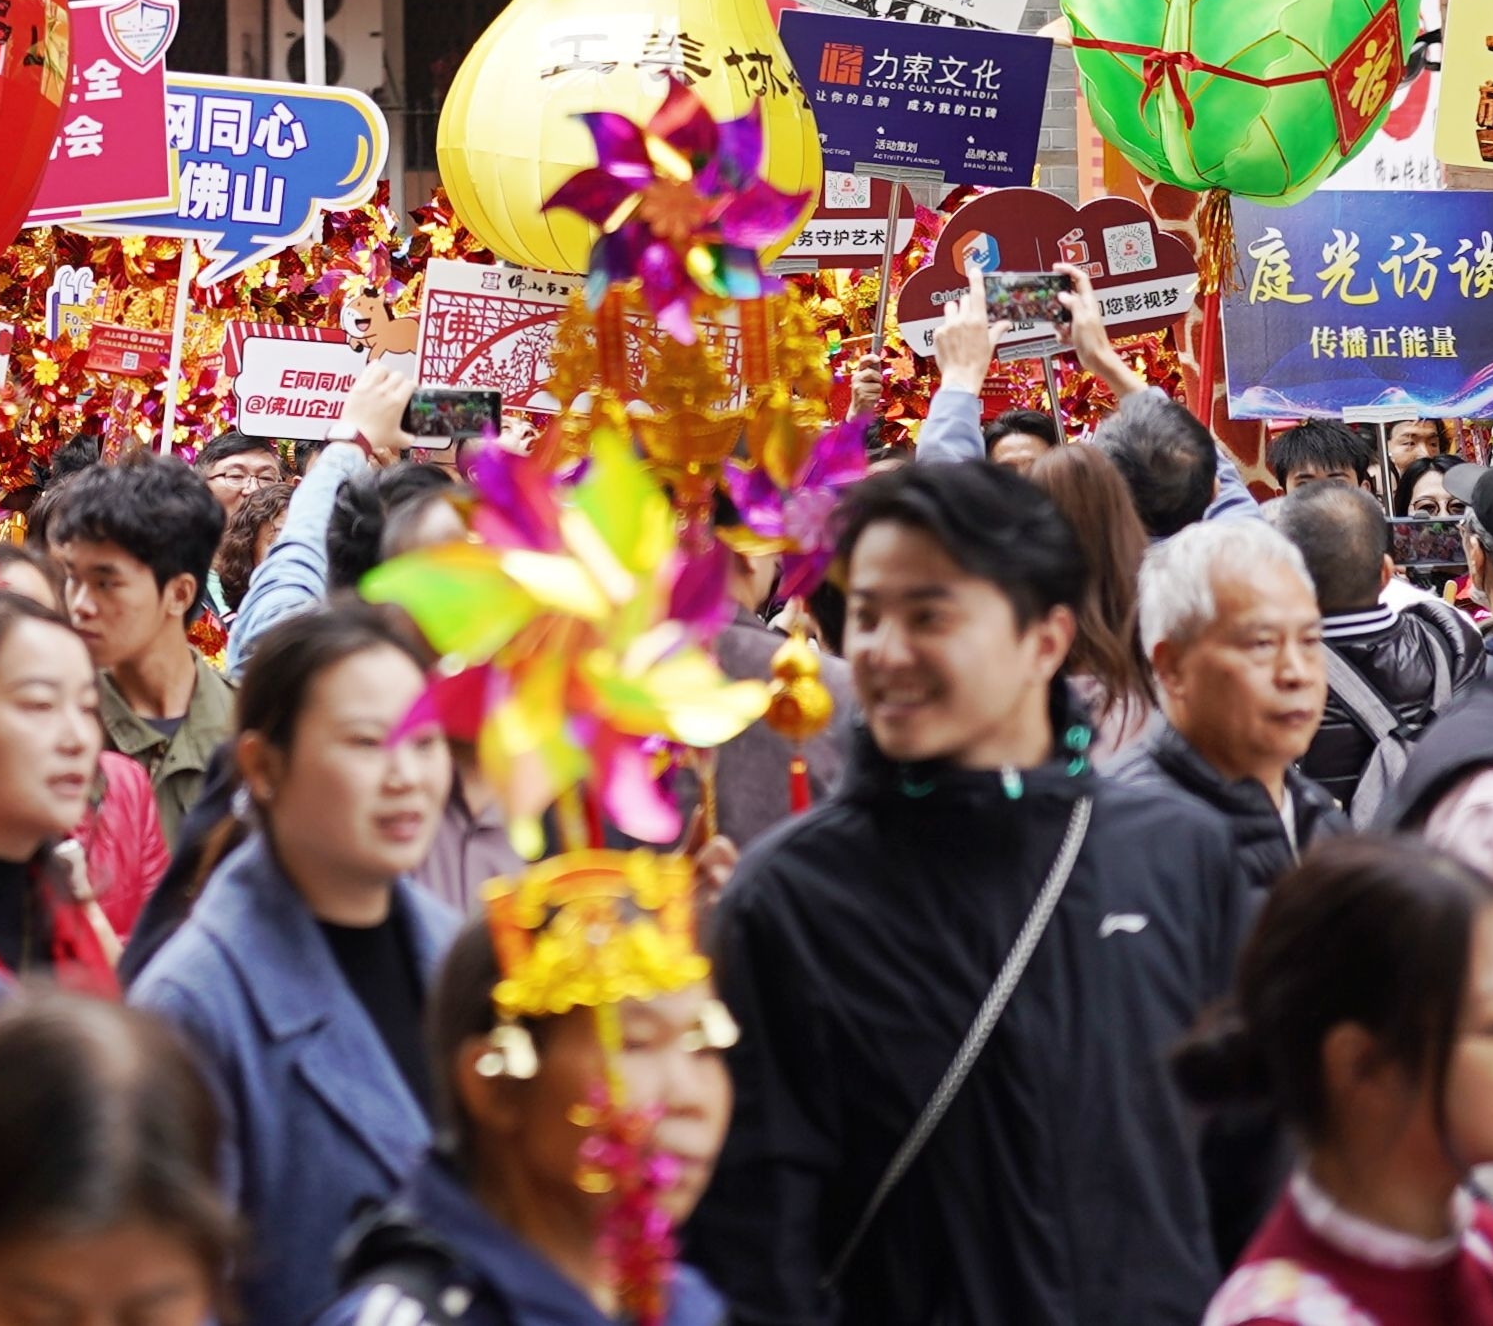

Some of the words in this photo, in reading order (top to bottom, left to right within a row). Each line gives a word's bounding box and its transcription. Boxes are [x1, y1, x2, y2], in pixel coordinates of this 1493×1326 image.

[69, 58, 122, 103] 全
[867, 49, 1002, 90] 力索文化
[816, 89, 891, 108] 让你的品牌
[907, 99, 998, 119] 成为我的口碑
[909, 85, 961, 96] CULTURE
[964, 90, 1000, 100] MEDIA
[49, 114, 103, 160] 会
[875, 139, 918, 153] 活动策划
[176, 160, 284, 227] 佛山
[508, 274, 584, 297] 佛山市工
[1309, 326, 1458, 359] 传播正能量
[280, 369, 356, 393] E网同心
